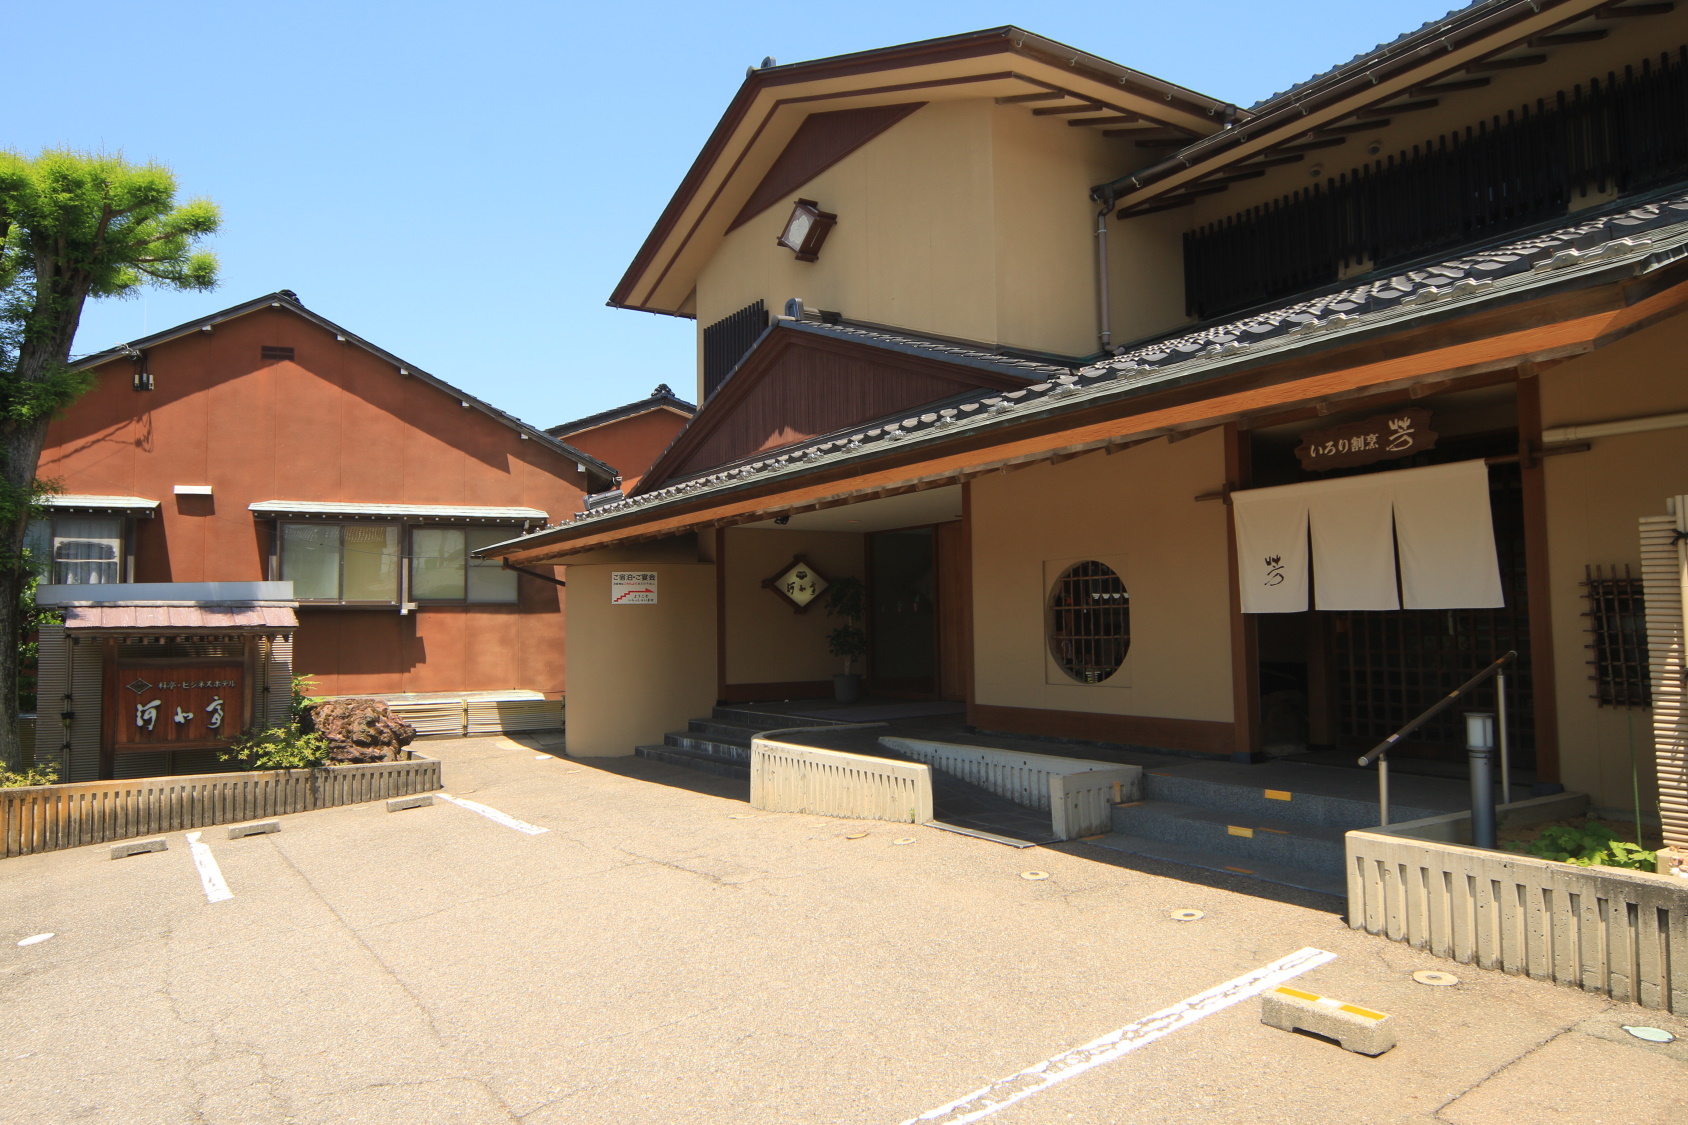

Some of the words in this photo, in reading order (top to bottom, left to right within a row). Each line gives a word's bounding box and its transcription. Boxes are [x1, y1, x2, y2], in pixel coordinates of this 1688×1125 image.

[1310, 433, 1379, 457] いろり割烹
